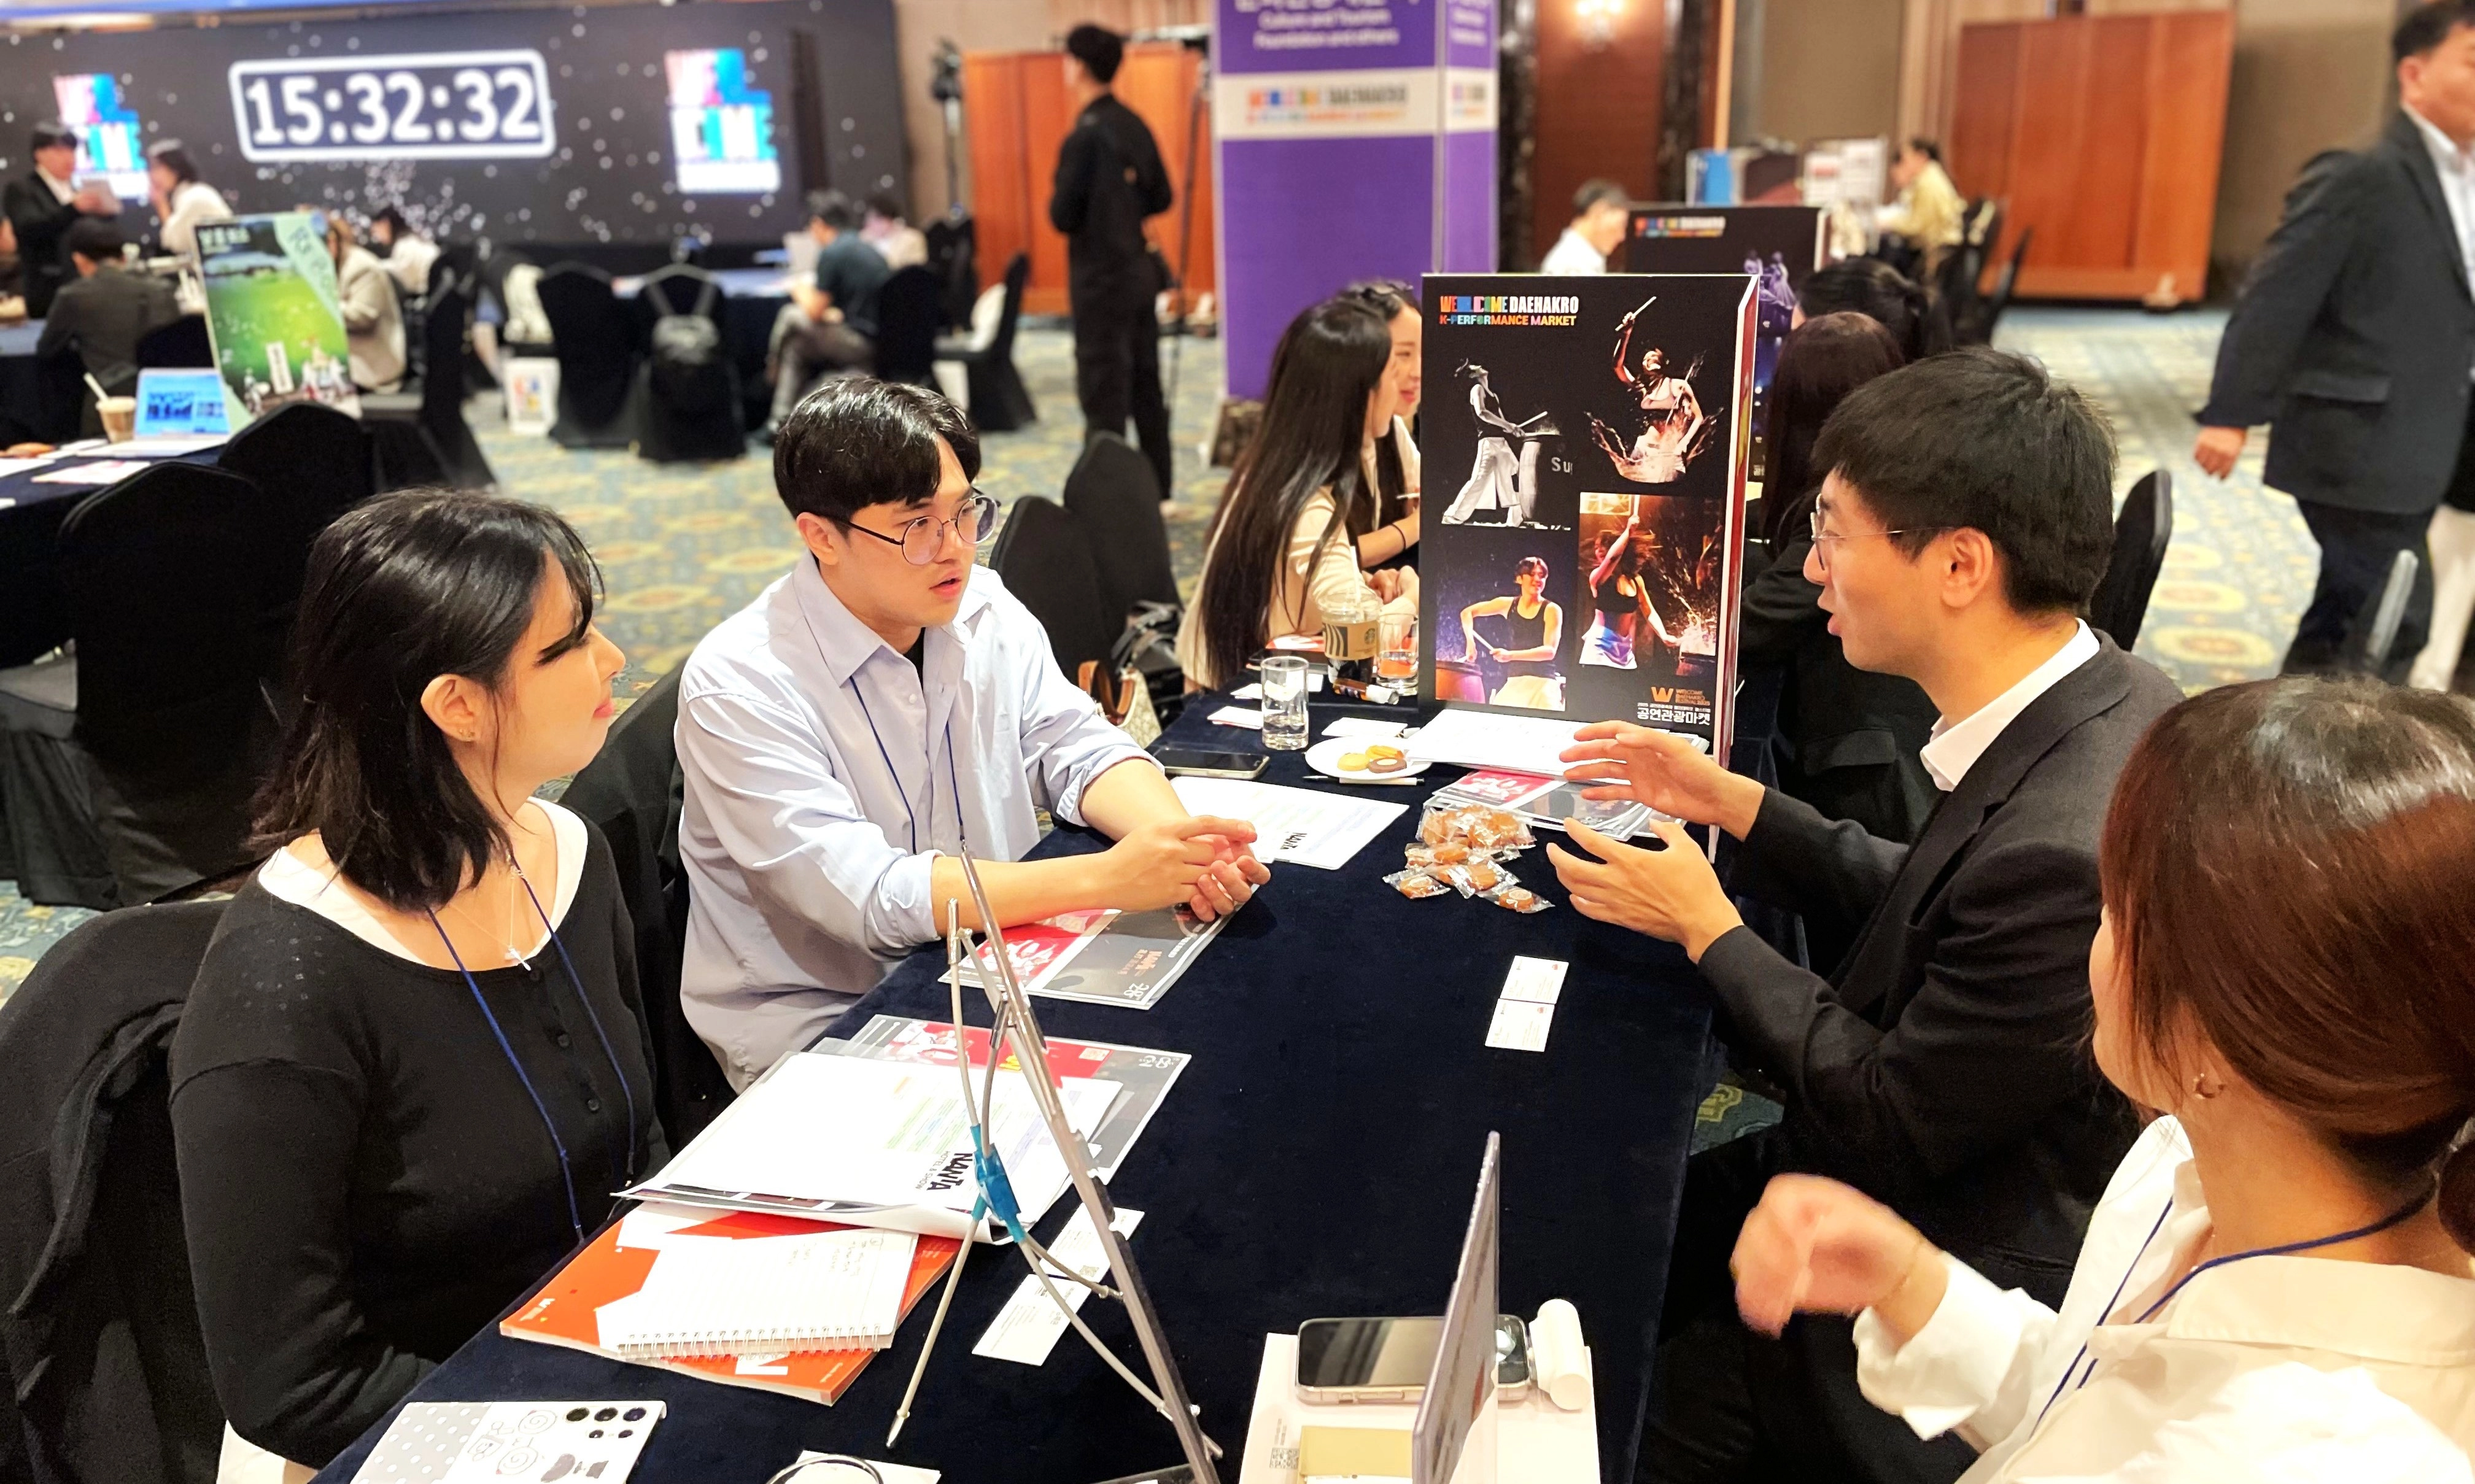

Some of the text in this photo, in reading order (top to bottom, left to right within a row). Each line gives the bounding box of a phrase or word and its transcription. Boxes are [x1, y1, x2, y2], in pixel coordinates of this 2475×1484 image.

[247, 67, 541, 145] 15:32:32
[1509, 296, 1579, 314] DAEHAKRO
[1439, 314, 1577, 326] K-PERFORMANCE MARKET
[1637, 707, 1710, 725] 공연관광마켓
[926, 1153, 973, 1191] NANTA
